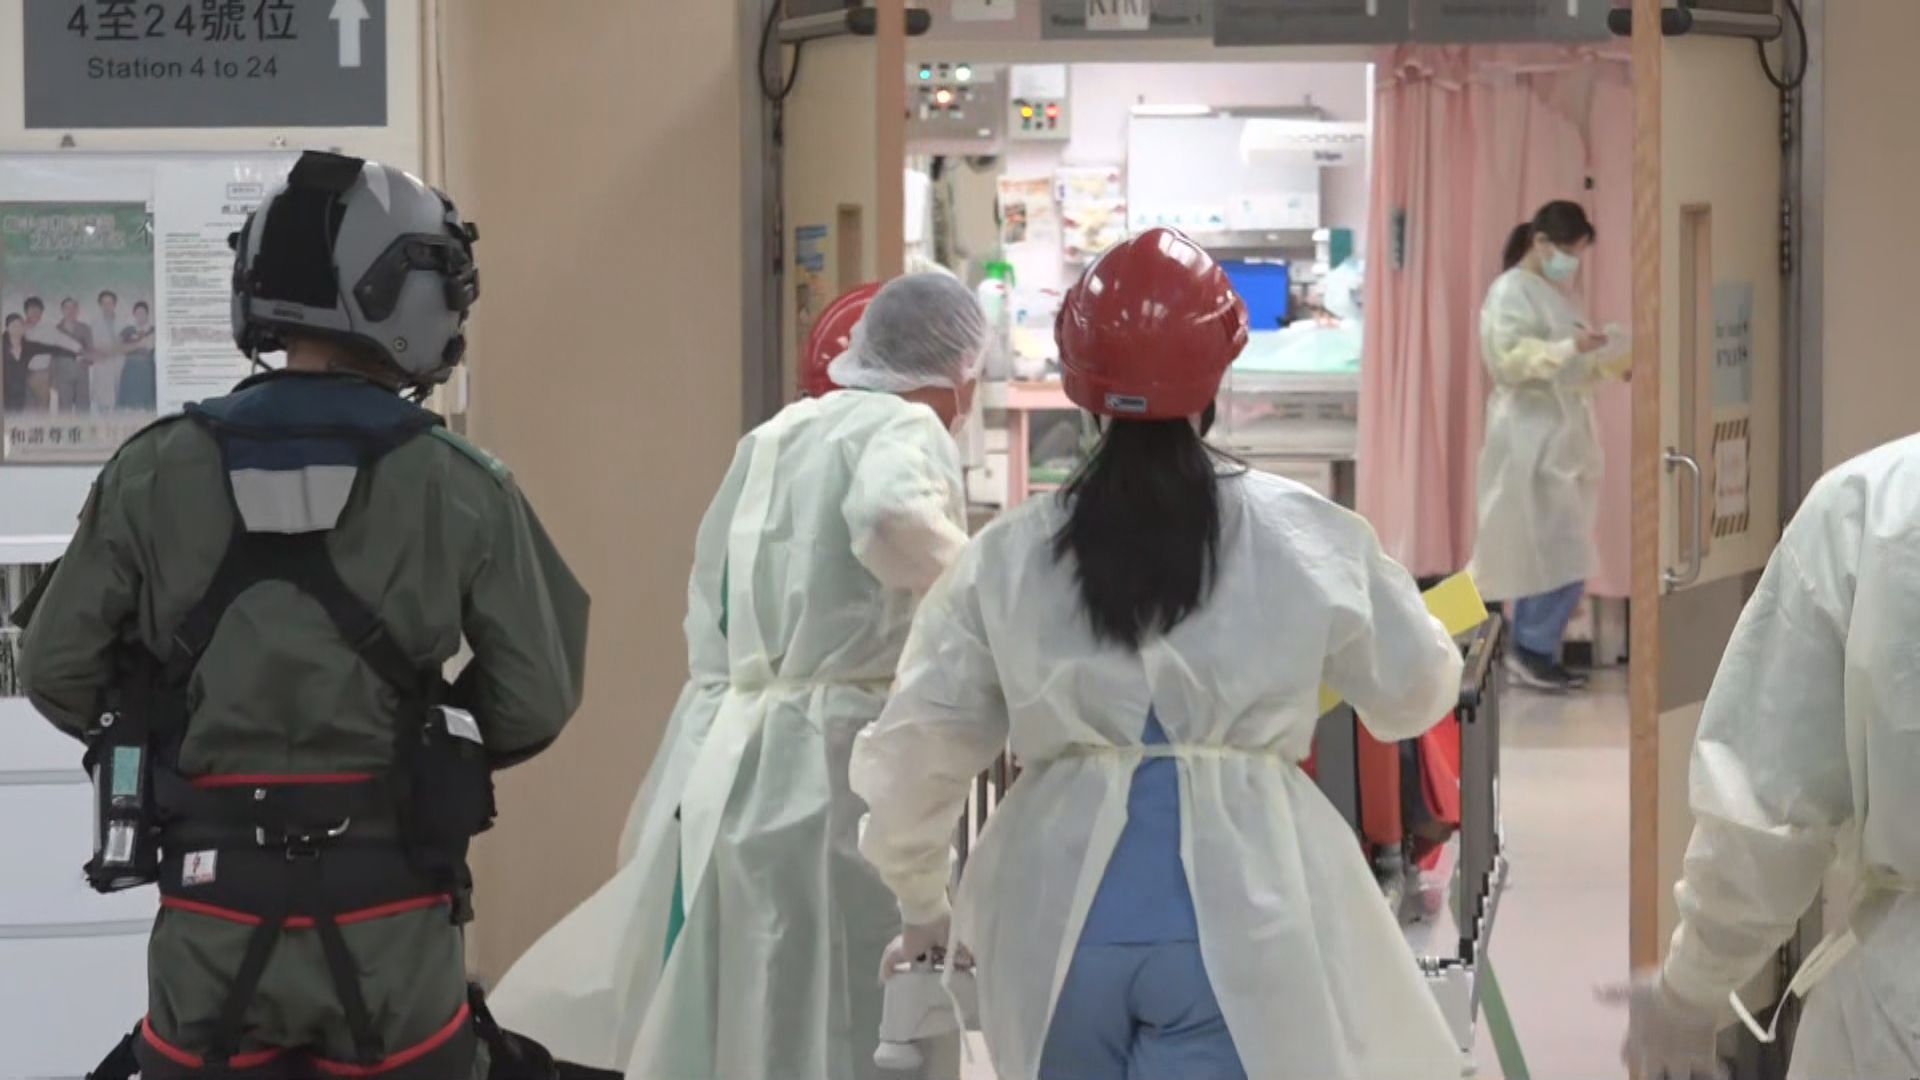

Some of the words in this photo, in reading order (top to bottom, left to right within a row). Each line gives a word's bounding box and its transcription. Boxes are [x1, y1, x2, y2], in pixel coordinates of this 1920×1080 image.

[67, 0, 297, 41] 4至24號位
[88, 57, 182, 79] Station
[190, 57, 204, 78] 4
[214, 57, 238, 78] to
[247, 57, 277, 78] 24
